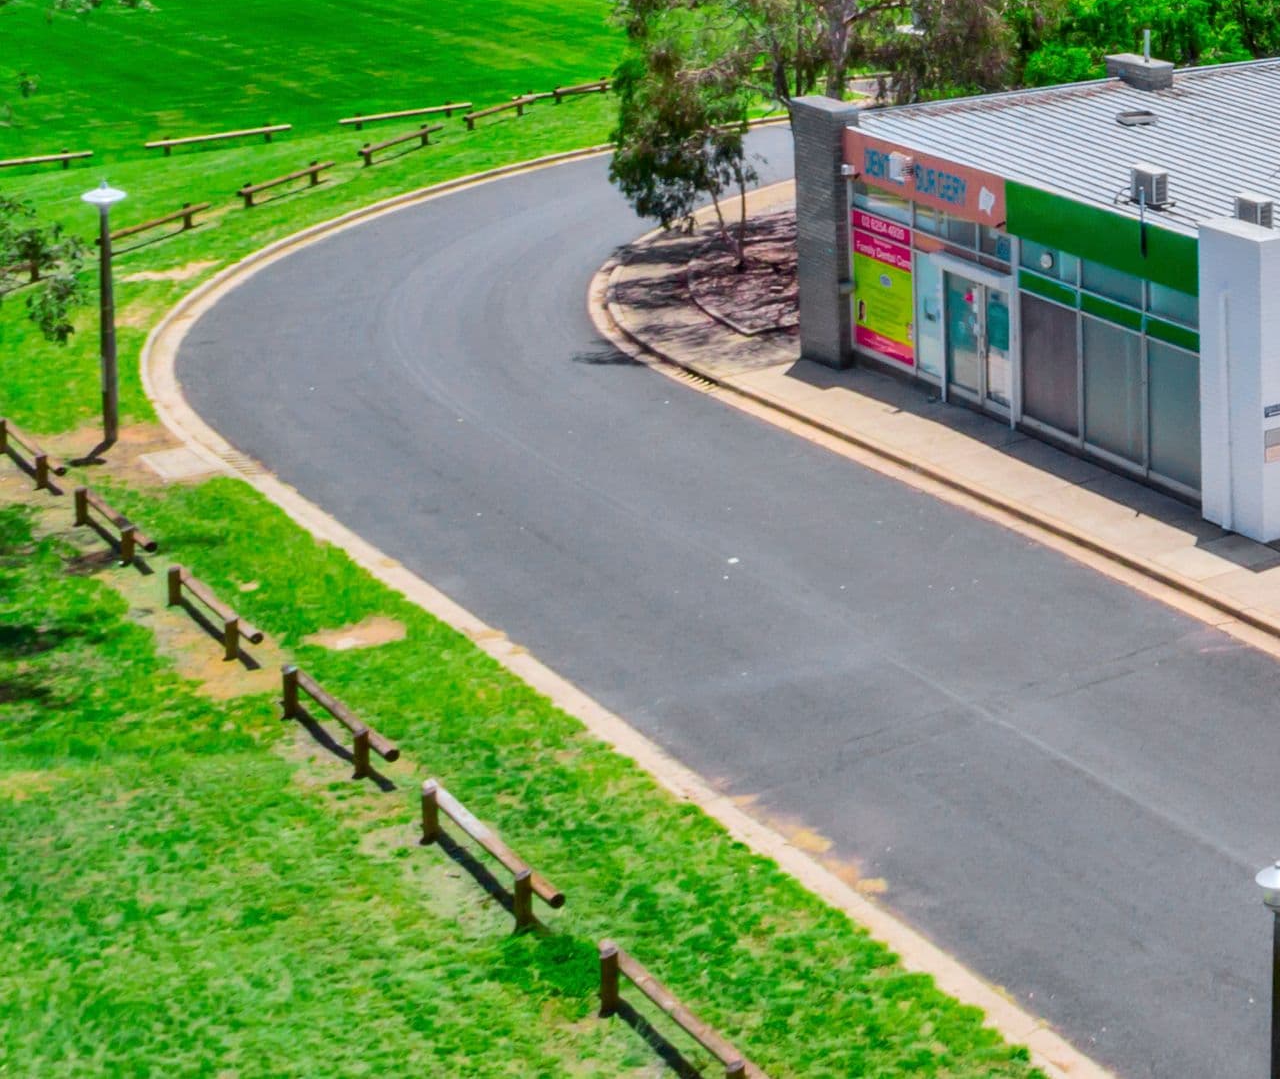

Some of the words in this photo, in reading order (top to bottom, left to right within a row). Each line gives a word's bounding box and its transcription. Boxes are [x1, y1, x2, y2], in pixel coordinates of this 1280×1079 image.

[914, 163, 966, 206] SURGERY
[856, 240, 876, 257] Family
[876, 247, 897, 263] Dental
